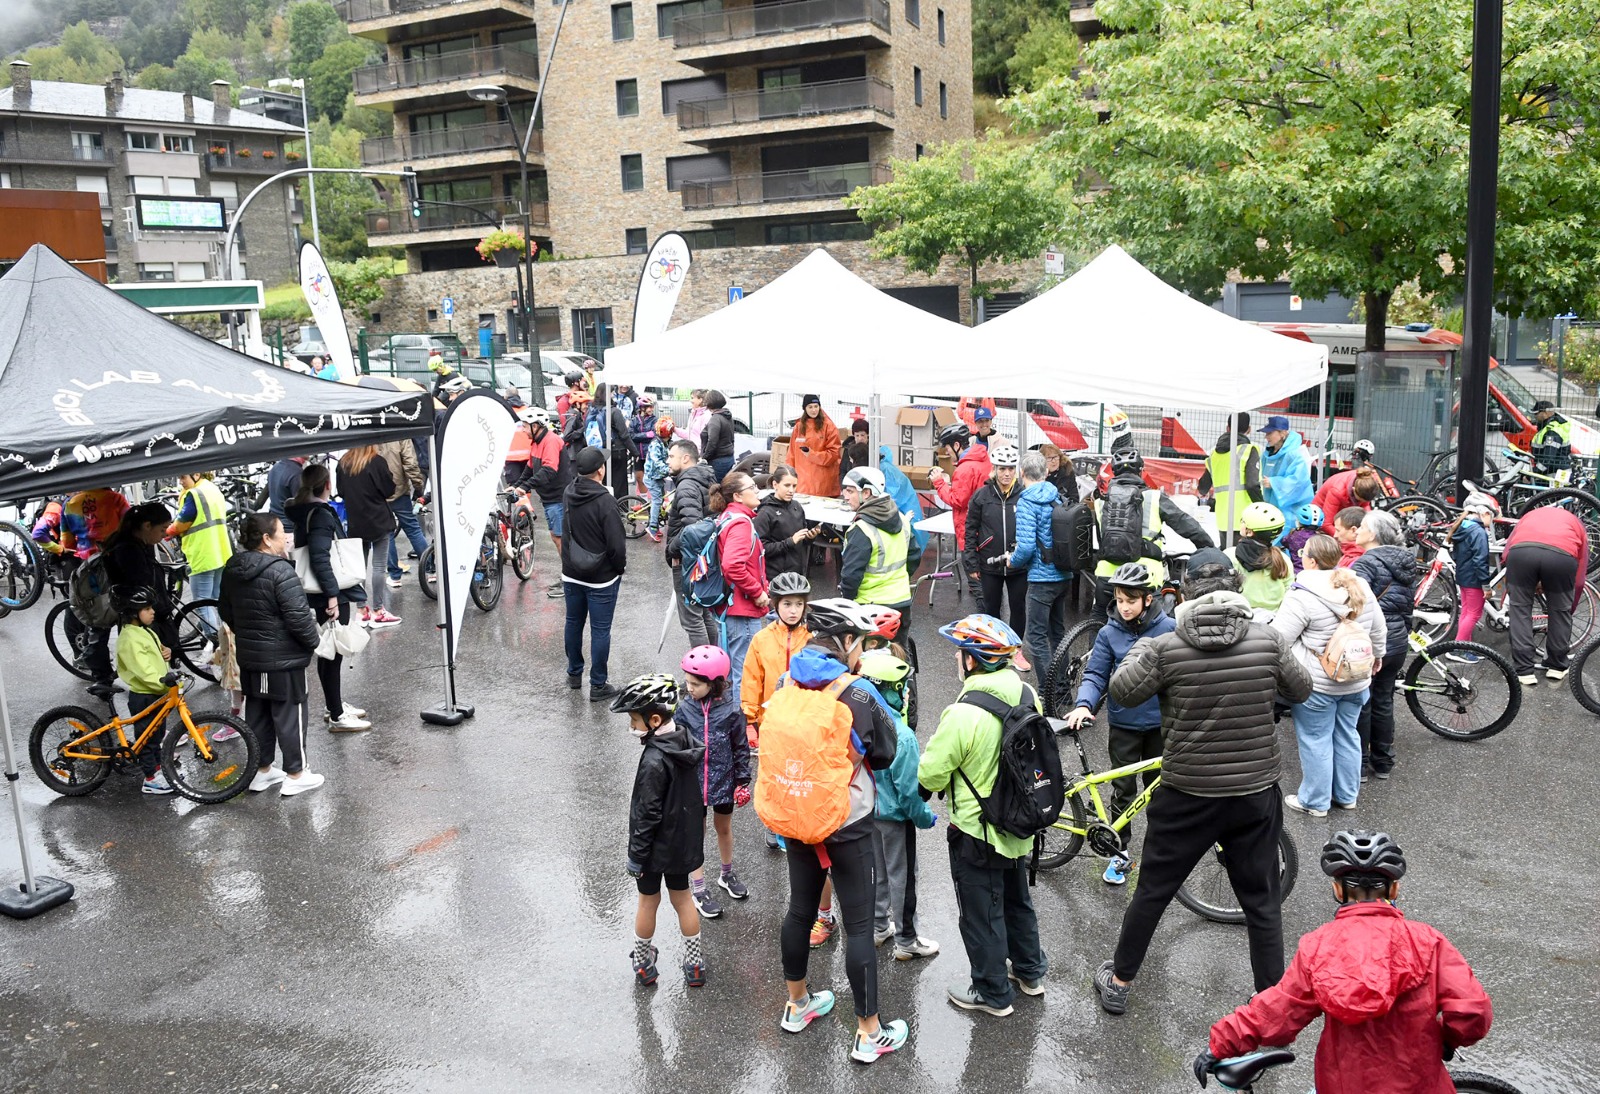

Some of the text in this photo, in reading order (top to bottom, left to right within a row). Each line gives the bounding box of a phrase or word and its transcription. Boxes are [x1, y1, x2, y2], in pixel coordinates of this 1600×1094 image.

[444, 300, 451, 312] P
[70, 370, 162, 391] LAB
[52, 388, 94, 426] BICI
[280, 416, 298, 424] LAB
[144, 426, 205, 456] BICI LAB ANDORRA
[0, 448, 60, 472] LAB ANDORRA
[456, 413, 496, 536] BICI LAB ANDORRA
